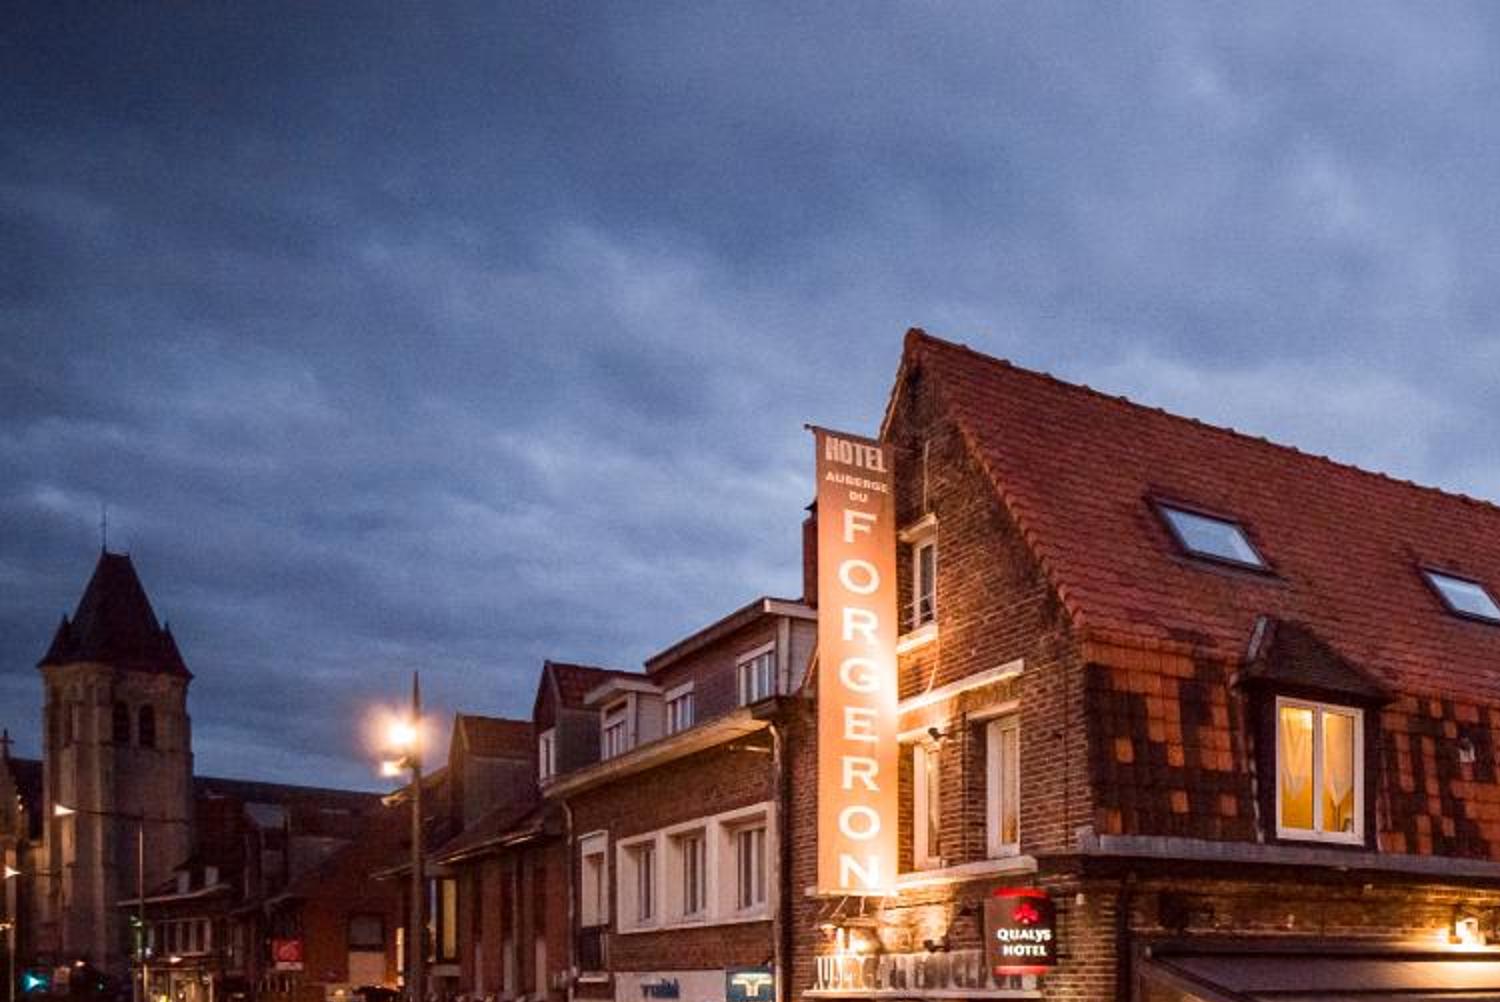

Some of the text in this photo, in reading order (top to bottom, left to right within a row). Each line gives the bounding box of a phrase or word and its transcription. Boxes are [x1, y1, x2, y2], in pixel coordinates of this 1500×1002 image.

[825, 435, 887, 472] HOTEL
[825, 471, 888, 493] AUBERGE
[849, 490, 868, 502] DU
[838, 508, 881, 889] FORGERON
[997, 929, 1052, 942] QUALYS
[1003, 945, 1047, 956] HOTEL
